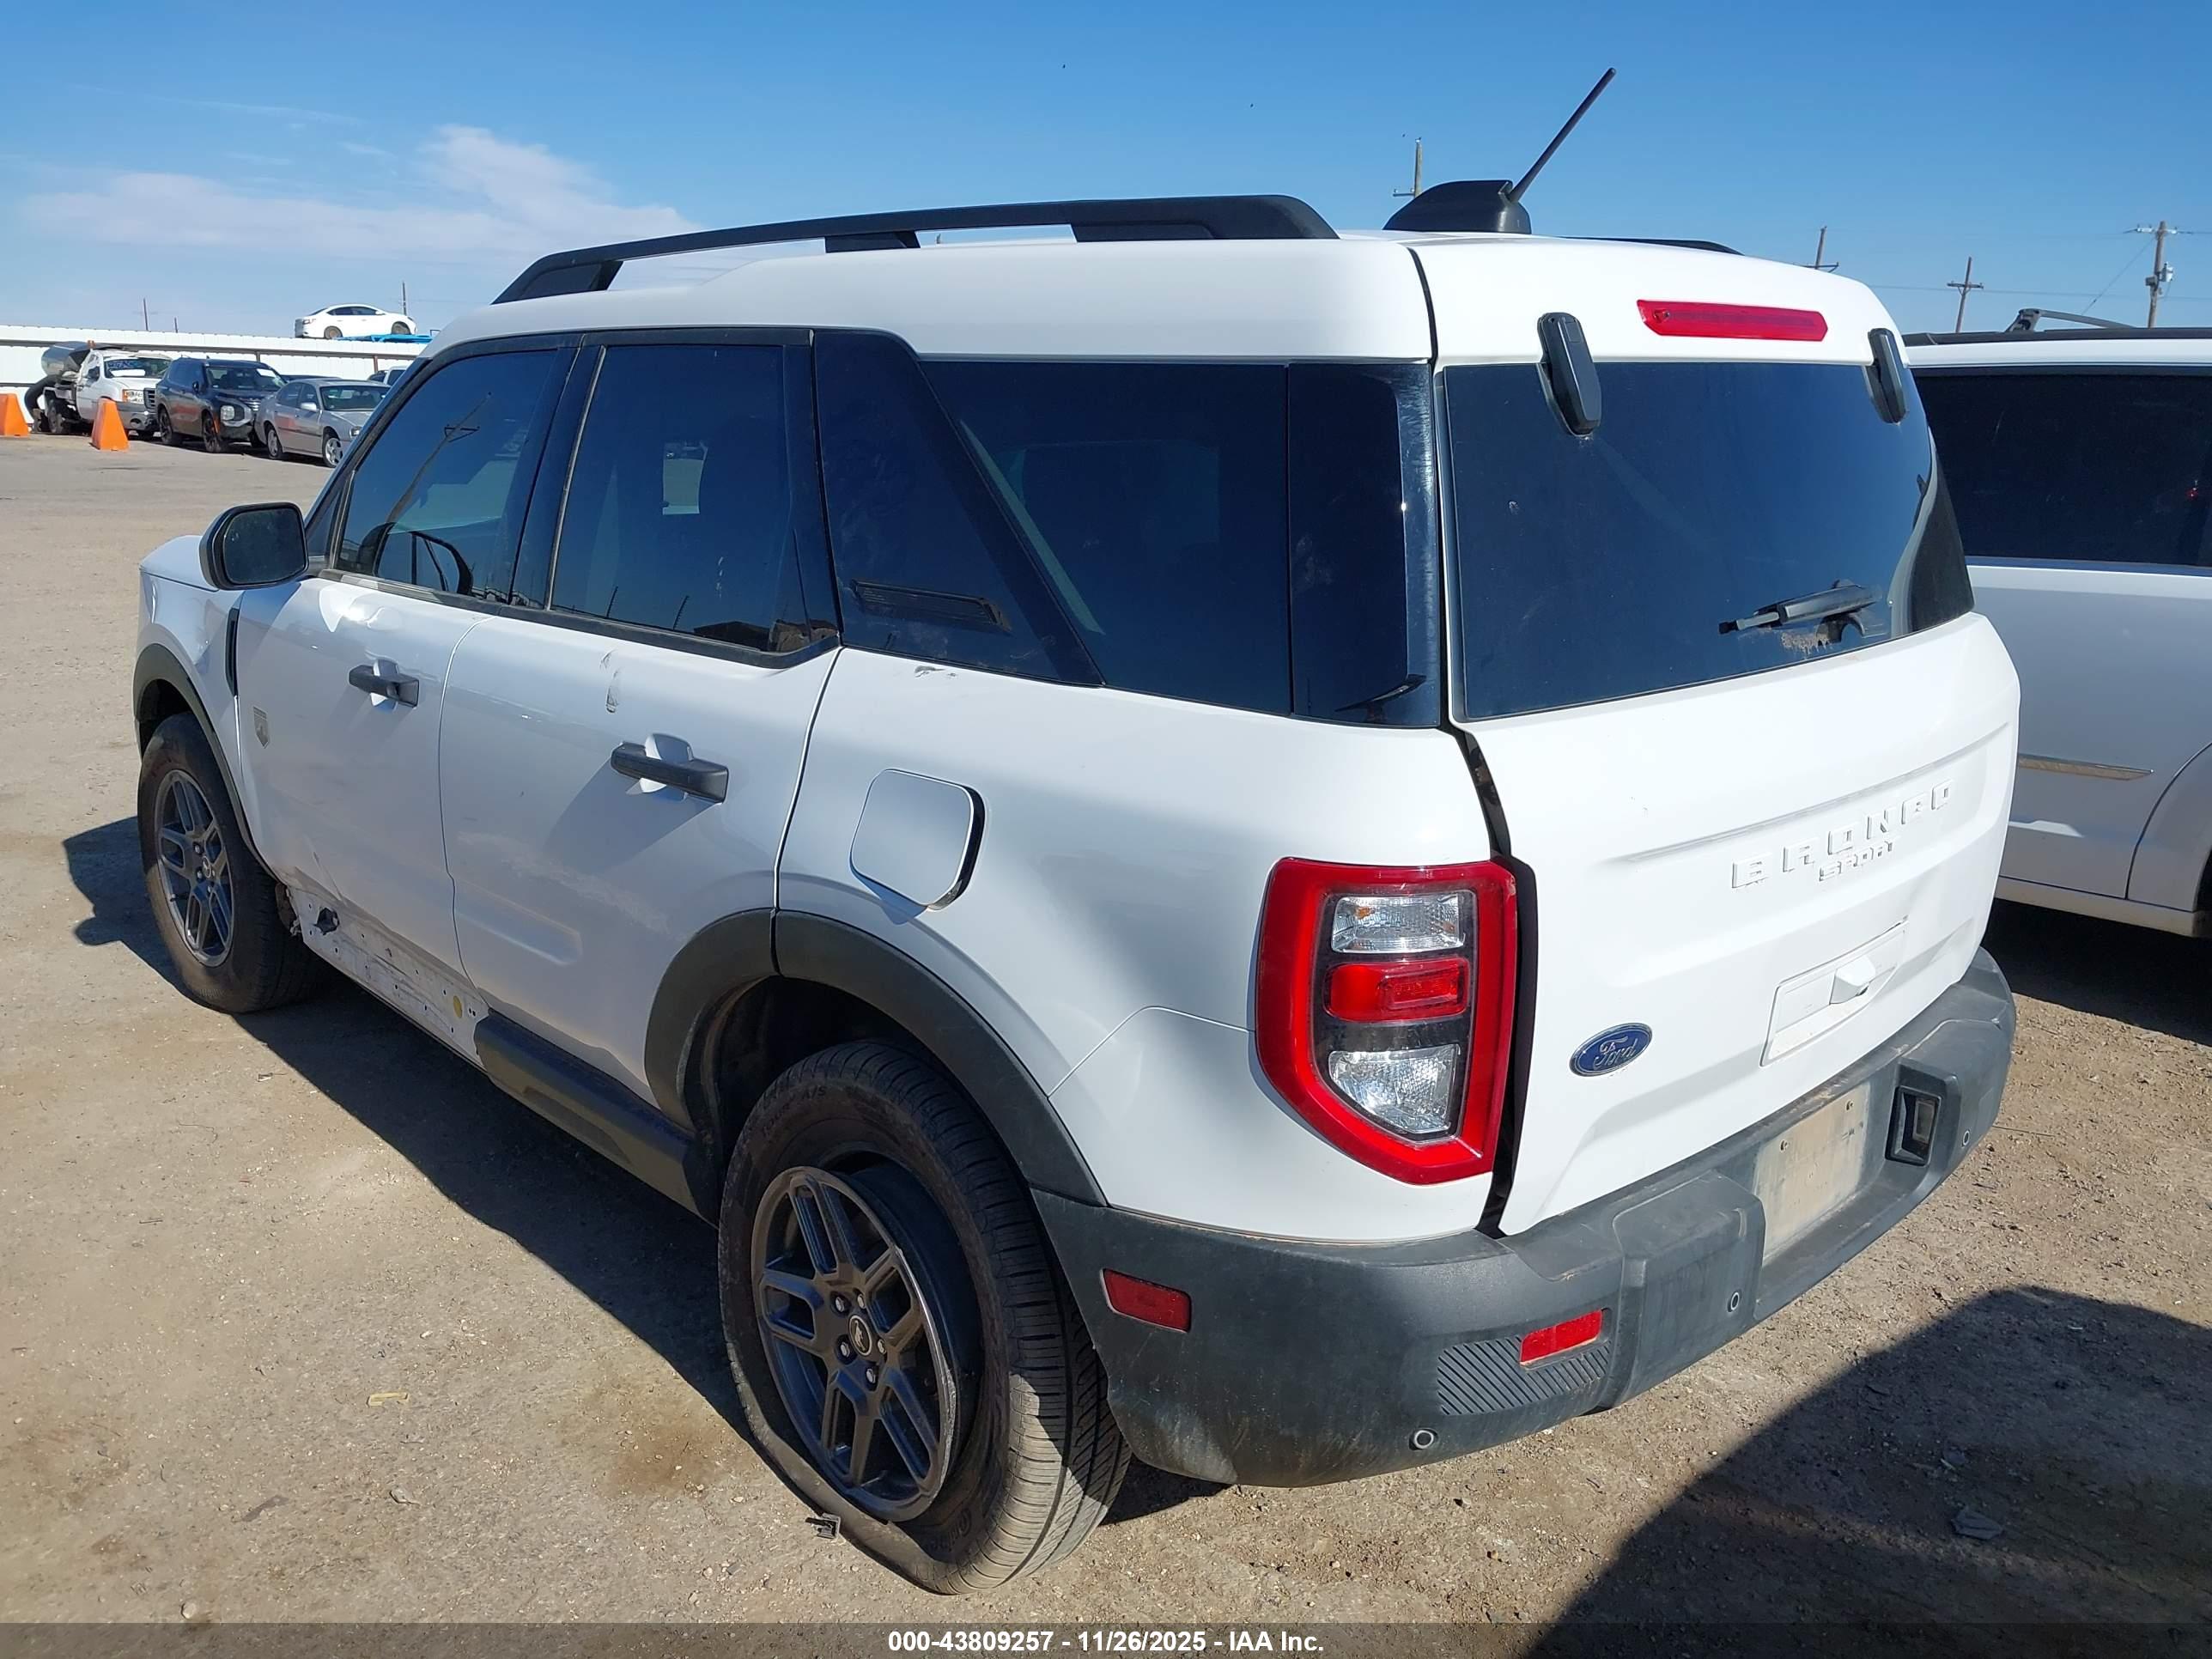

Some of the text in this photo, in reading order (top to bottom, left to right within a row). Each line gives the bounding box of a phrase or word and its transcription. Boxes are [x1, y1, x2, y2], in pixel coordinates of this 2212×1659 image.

[1732, 778, 1954, 888] BRONCO
[1819, 836, 1899, 882] SPORT
[1593, 1036, 1638, 1070] Ford
